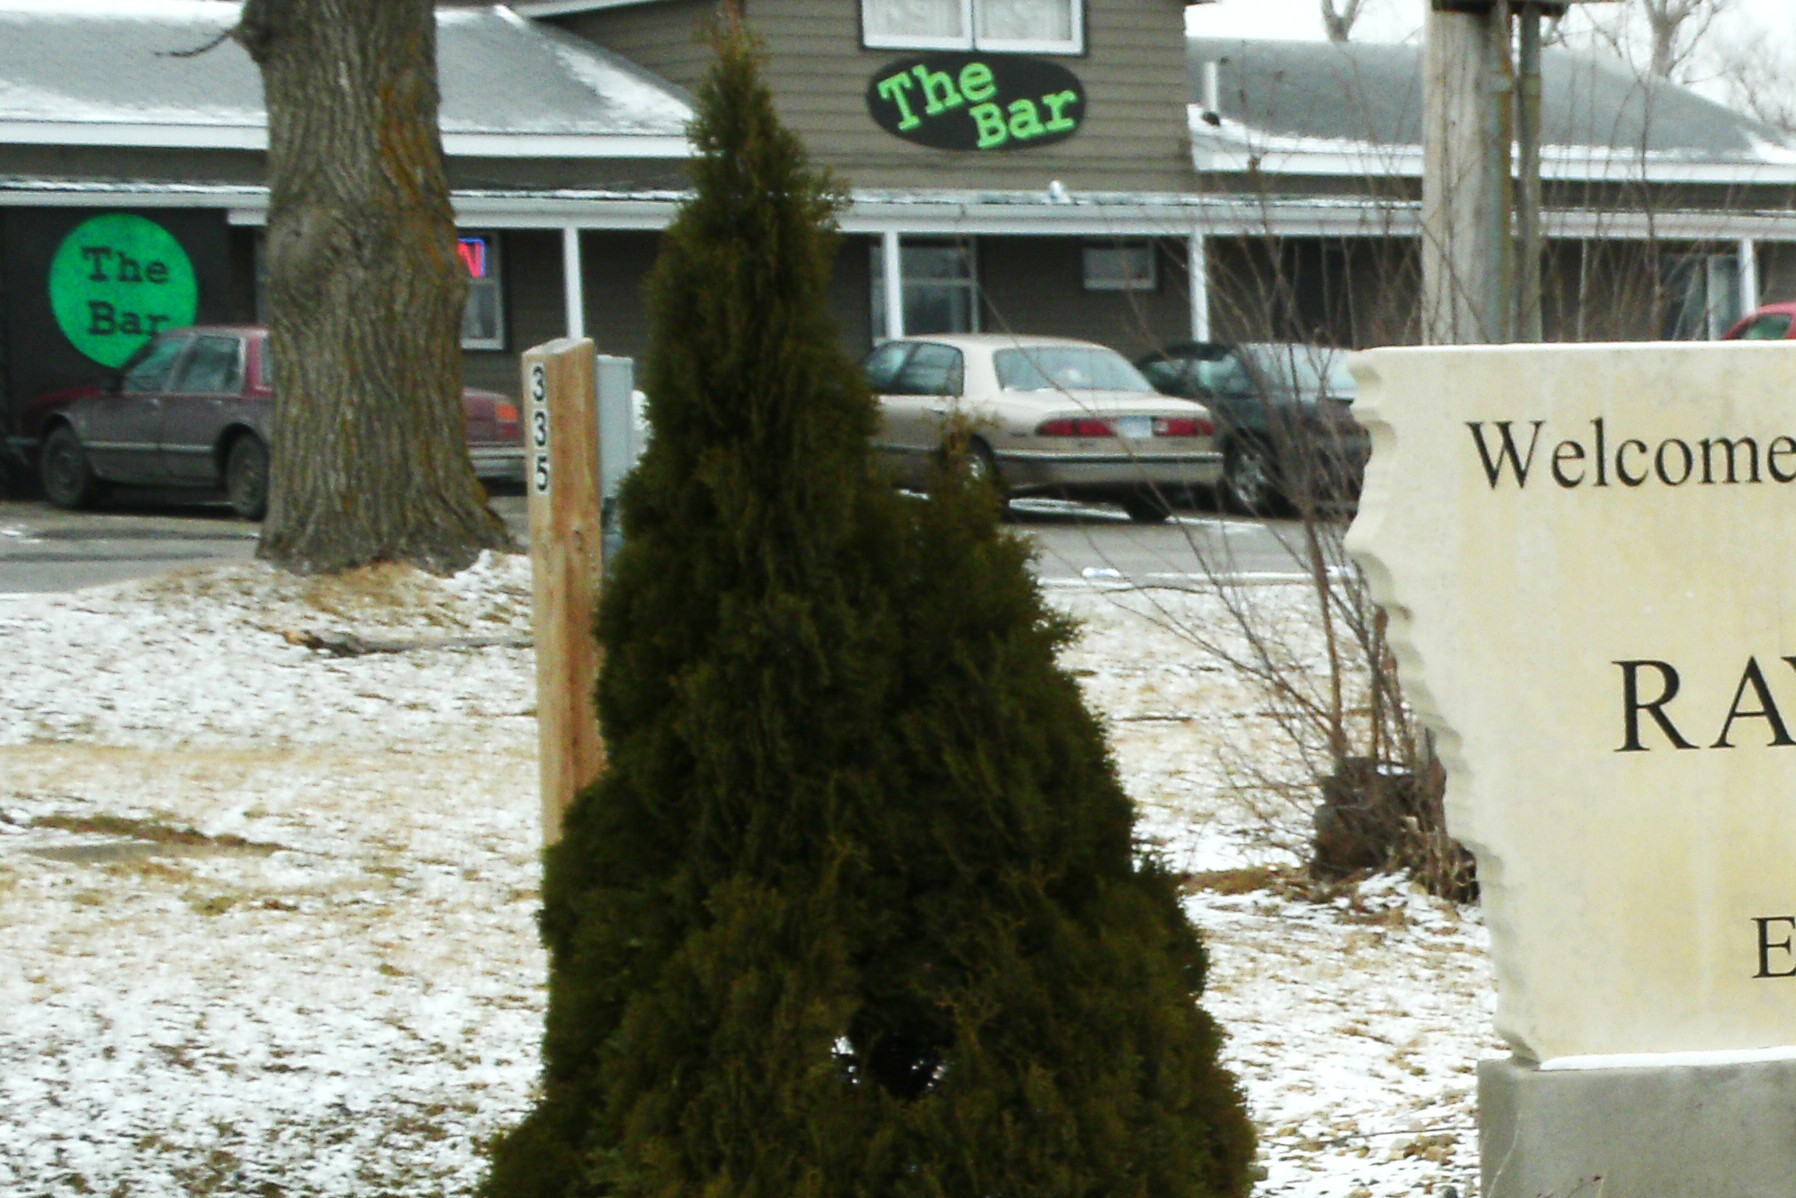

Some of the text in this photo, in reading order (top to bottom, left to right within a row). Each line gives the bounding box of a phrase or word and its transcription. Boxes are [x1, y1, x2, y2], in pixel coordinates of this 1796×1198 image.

[877, 62, 997, 131] The
[968, 90, 1078, 148] Bar
[81, 247, 169, 284] The
[87, 300, 171, 336] Bar
